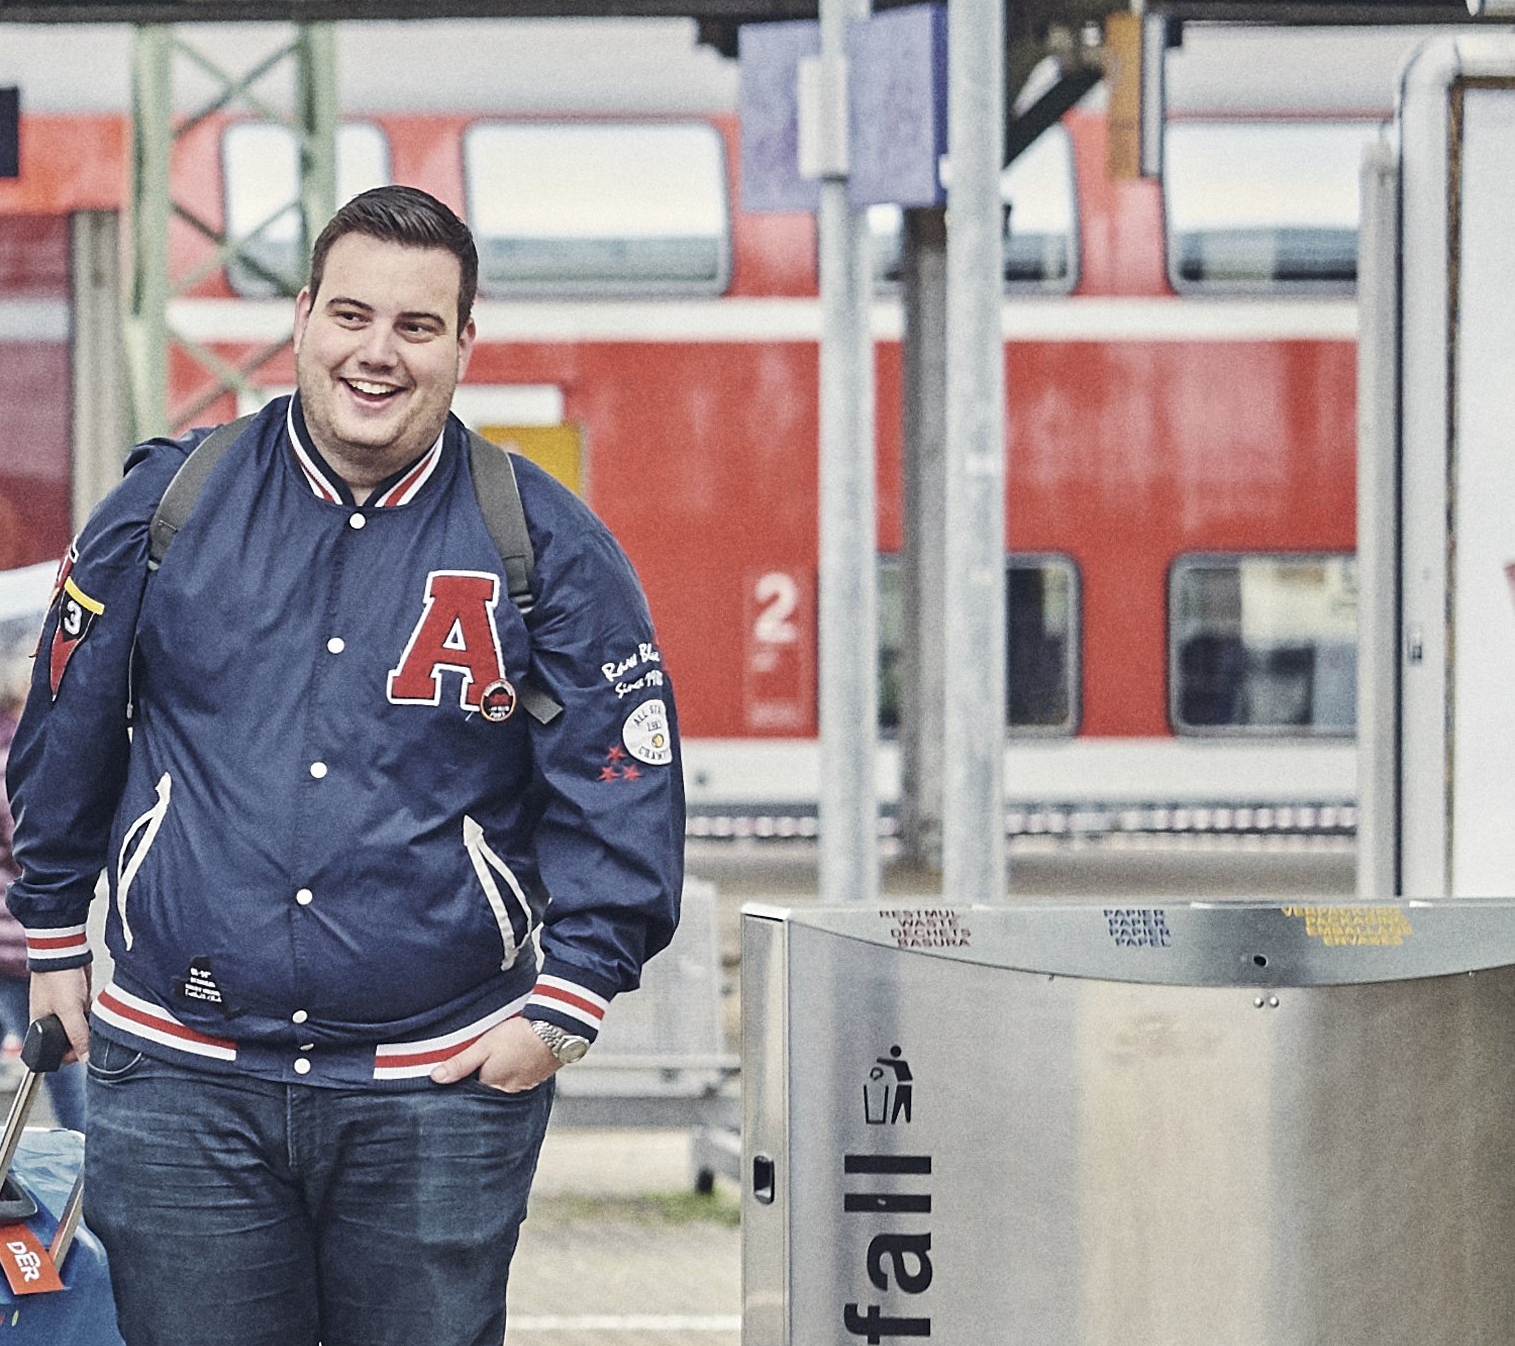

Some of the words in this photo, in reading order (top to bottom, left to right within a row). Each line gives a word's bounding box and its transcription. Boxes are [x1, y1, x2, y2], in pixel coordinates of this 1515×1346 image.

[63, 599, 83, 636] 3
[754, 571, 799, 644] 2
[386, 569, 506, 712] A
[6, 1241, 42, 1283] DER
